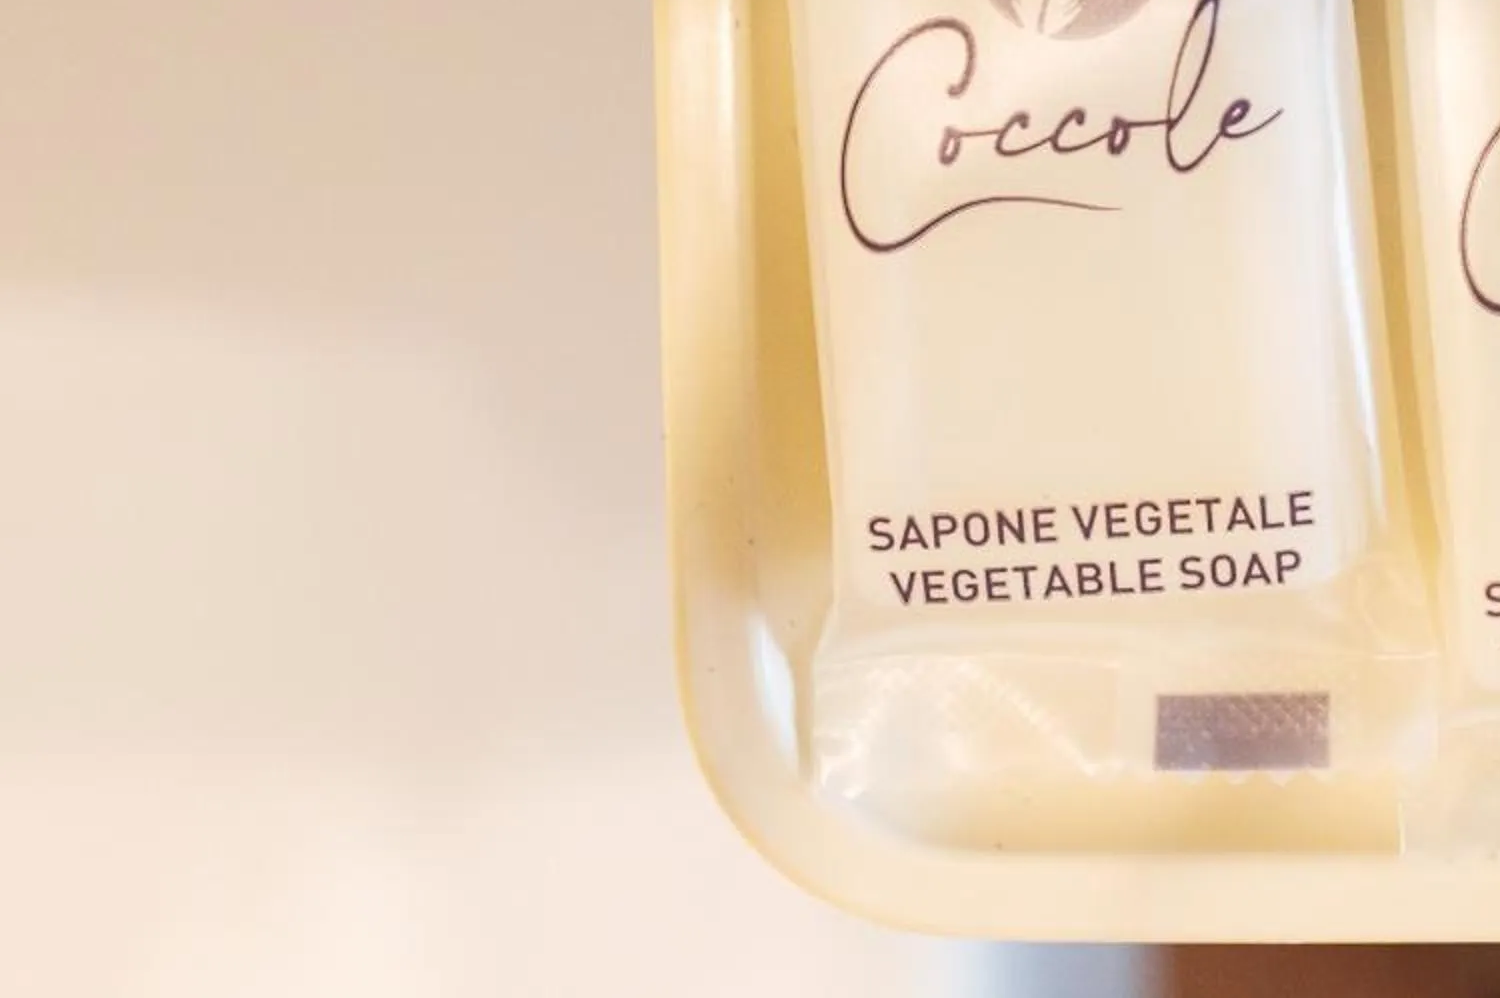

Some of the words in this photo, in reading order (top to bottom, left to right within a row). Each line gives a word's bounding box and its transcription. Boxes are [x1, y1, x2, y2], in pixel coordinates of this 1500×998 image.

[867, 507, 1058, 552] SAPONE
[1070, 490, 1316, 542] VEGETALE
[889, 557, 1165, 605] VEGETABLE
[1178, 549, 1302, 591] SOAP
